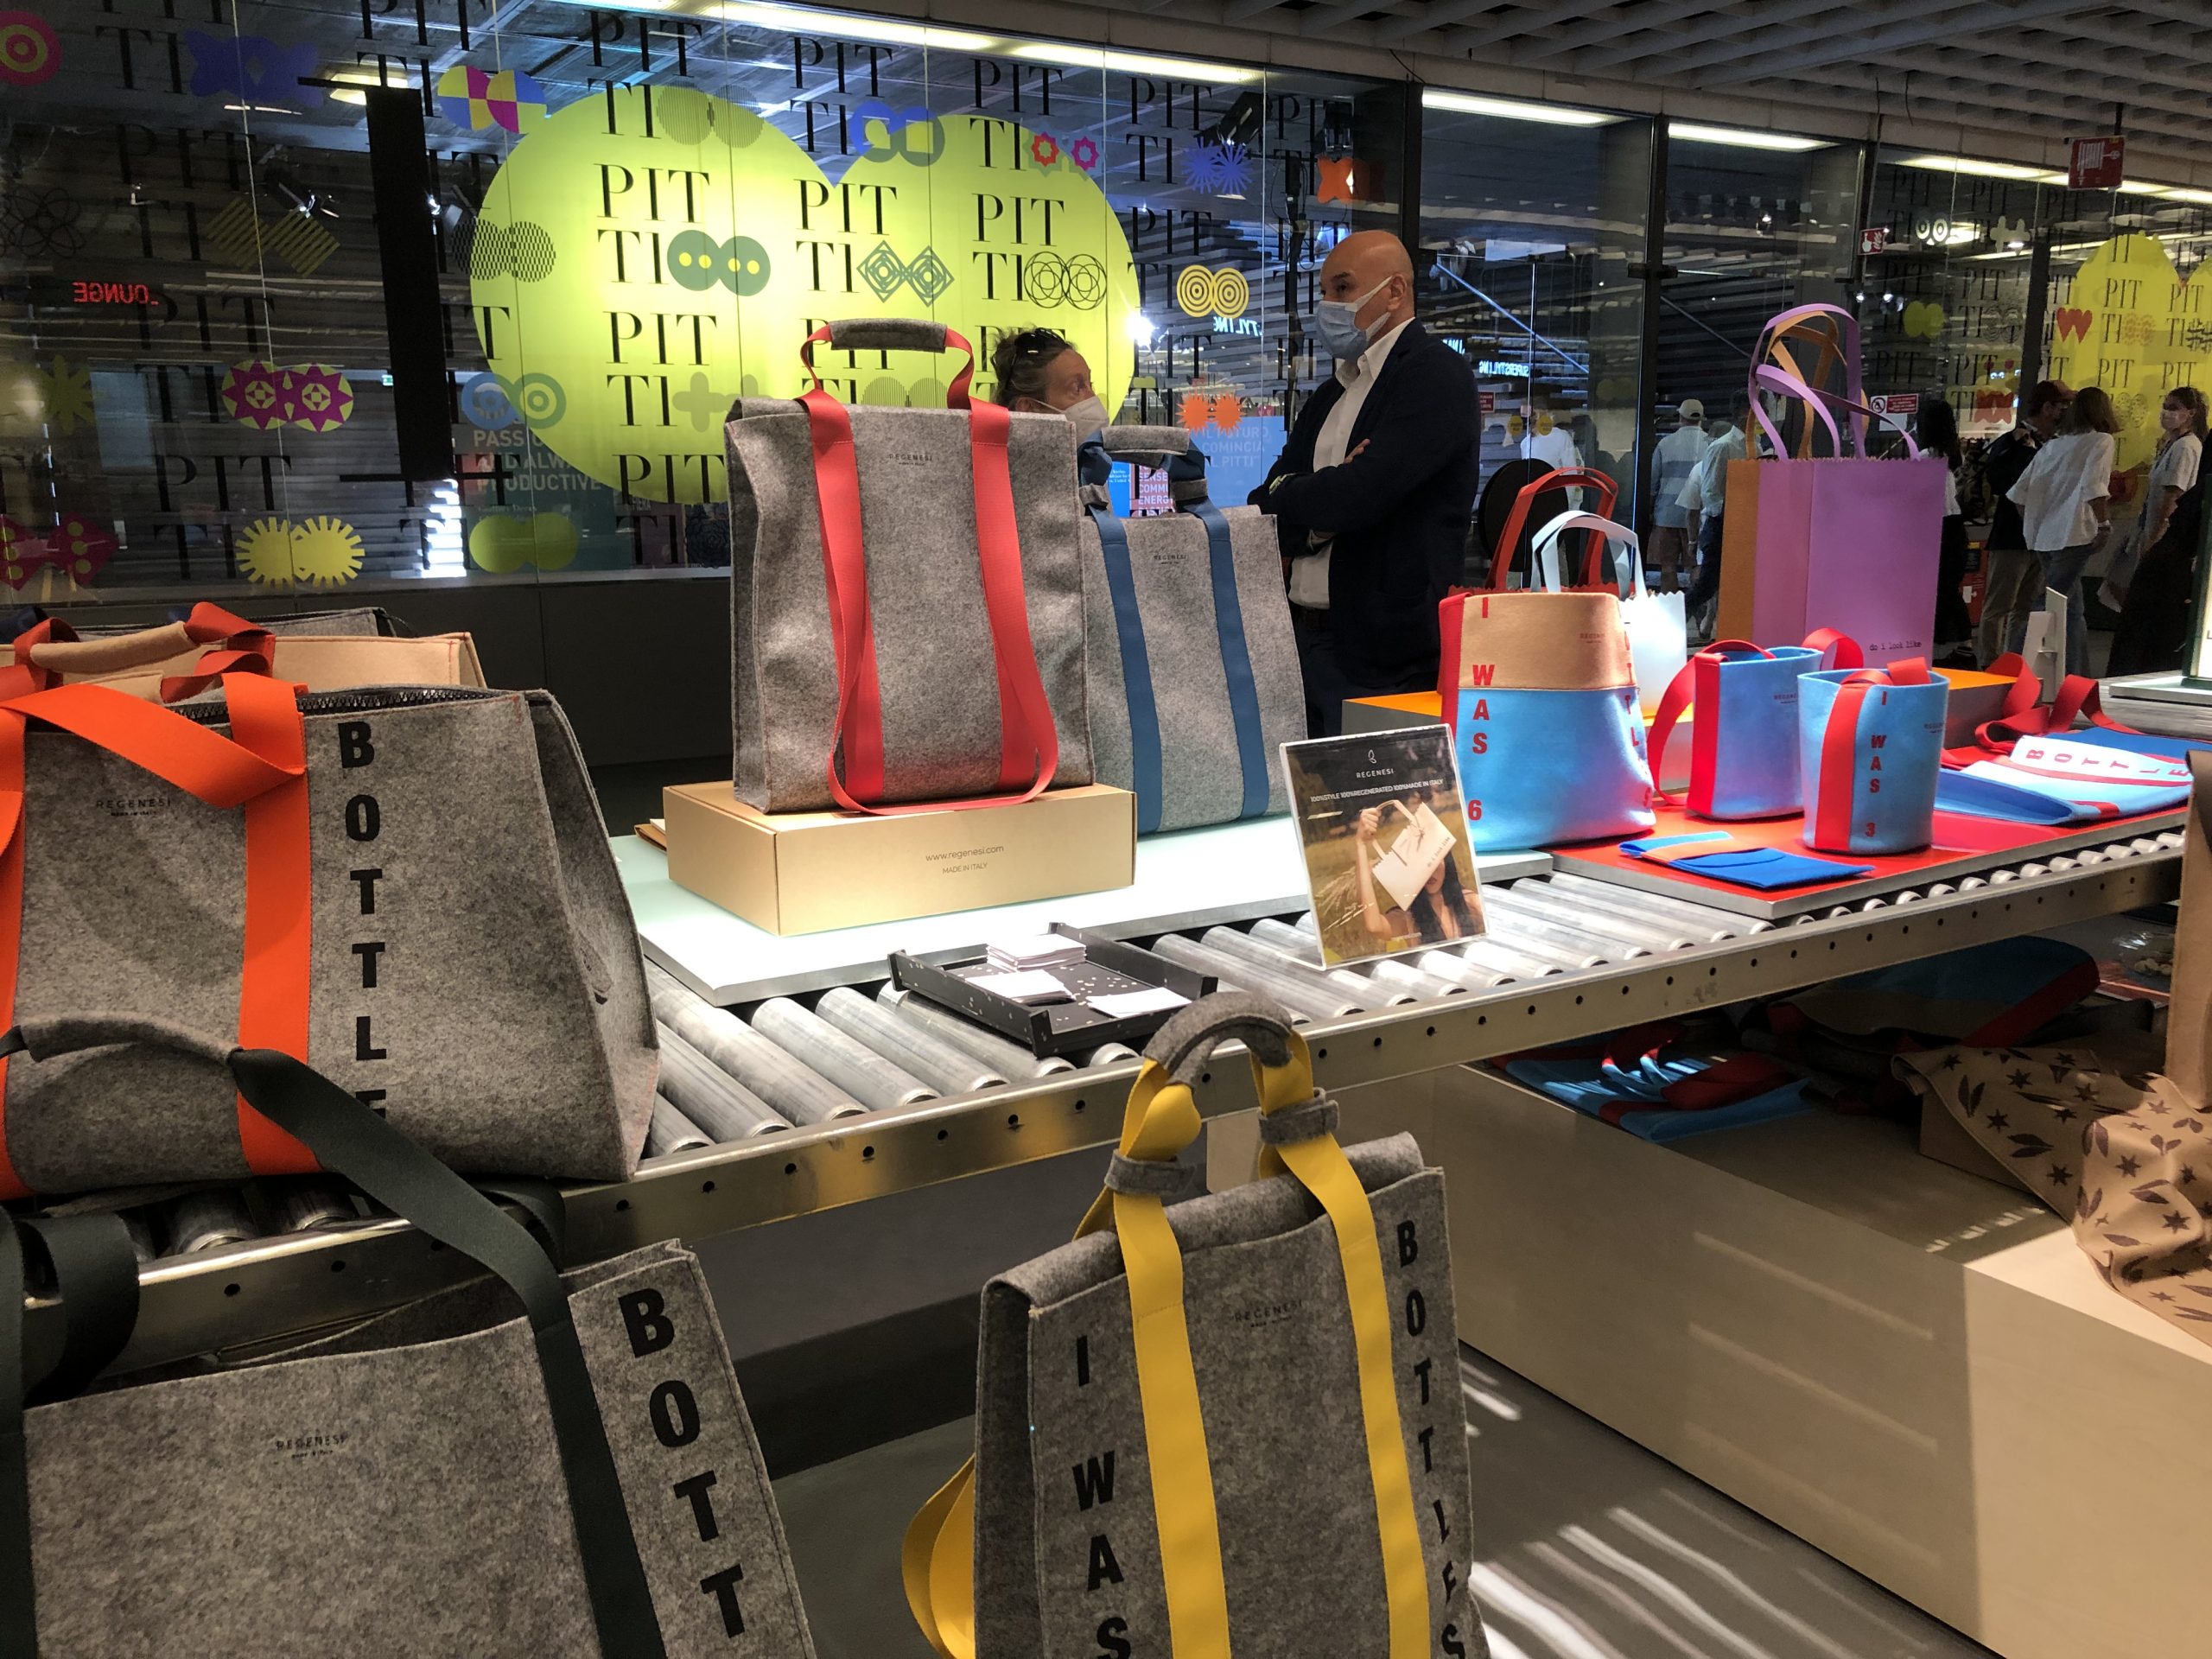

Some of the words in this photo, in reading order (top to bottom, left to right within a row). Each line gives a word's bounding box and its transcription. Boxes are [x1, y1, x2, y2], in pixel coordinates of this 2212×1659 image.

[589, 10, 702, 77] PIT
[787, 35, 893, 98] PIT
[588, 79, 662, 139] TI
[971, 59, 1063, 116] PIT
[1128, 76, 1212, 131] PIT
[790, 99, 855, 156] TI
[969, 118, 1027, 170] TI
[1126, 133, 1177, 185] TI
[594, 163, 710, 223] PIT
[793, 179, 898, 236] PIT
[972, 193, 1065, 246] PIT
[1128, 207, 1212, 257] PIT
[598, 230, 669, 284] TI
[796, 240, 860, 293] TI
[972, 251, 1028, 302] TI
[2103, 277, 2143, 310] PIT
[2168, 283, 2204, 314] PIT
[603, 311, 717, 366] PIT
[2101, 313, 2123, 344] TI
[2166, 317, 2186, 346] TI
[2097, 358, 2135, 389] PIT
[2161, 361, 2197, 390] PIT
[607, 375, 678, 427] TI
[474, 429, 544, 448] PASSO
[147, 454, 292, 513] PIT
[613, 454, 724, 505] PIT
[1139, 484, 1169, 493] COMM
[616, 515, 690, 565] TI
[1471, 664, 1496, 755] WAS
[1356, 767, 1395, 779] REGENESI
[1869, 734, 1887, 794] WAS
[2024, 748, 2191, 778] BOTTLE
[96, 798, 172, 809] REGENESI
[1467, 799, 1483, 822] 6
[925, 845, 1004, 861] www.regenesi.com
[1865, 823, 1876, 837] 3
[942, 865, 962, 874] MADE
[970, 862, 988, 871] ITALY
[1076, 1334, 1090, 1388] I
[618, 1287, 746, 1639] BOTT
[1071, 1450, 1132, 1659] WAS
